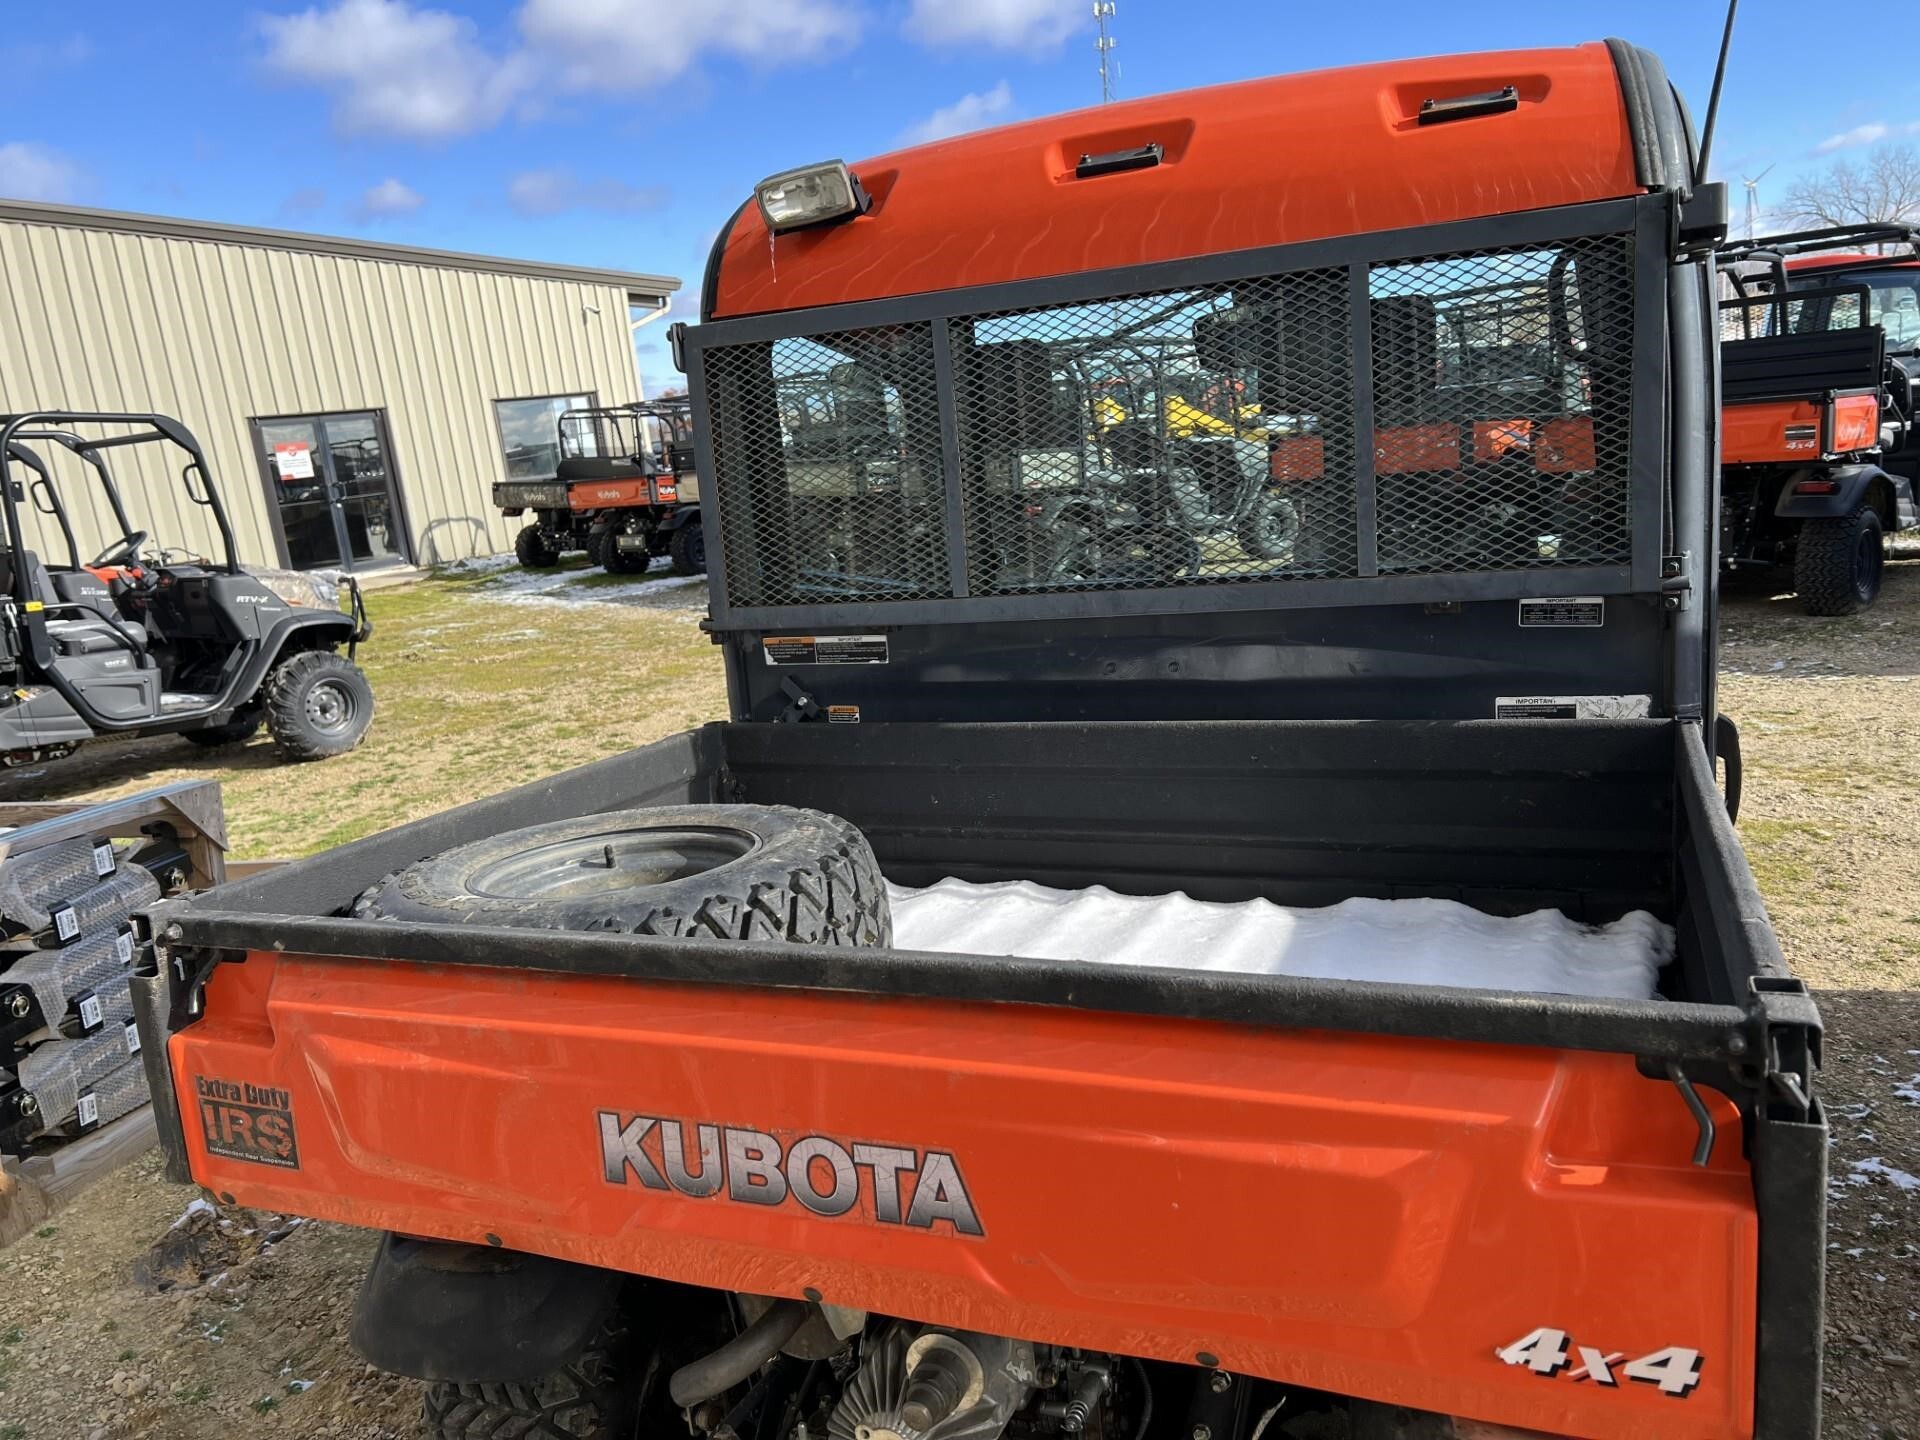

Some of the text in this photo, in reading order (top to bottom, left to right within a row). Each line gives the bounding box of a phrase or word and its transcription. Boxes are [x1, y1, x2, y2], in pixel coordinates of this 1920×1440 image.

[1786, 440, 1815, 450] 4x4
[196, 1076, 289, 1110] Extra Duty
[203, 1104, 292, 1157] IRS
[209, 1145, 295, 1167] Independent Rear Suspension
[598, 1109, 984, 1236] KUBOTA
[1494, 1326, 1704, 1398] 4x4
